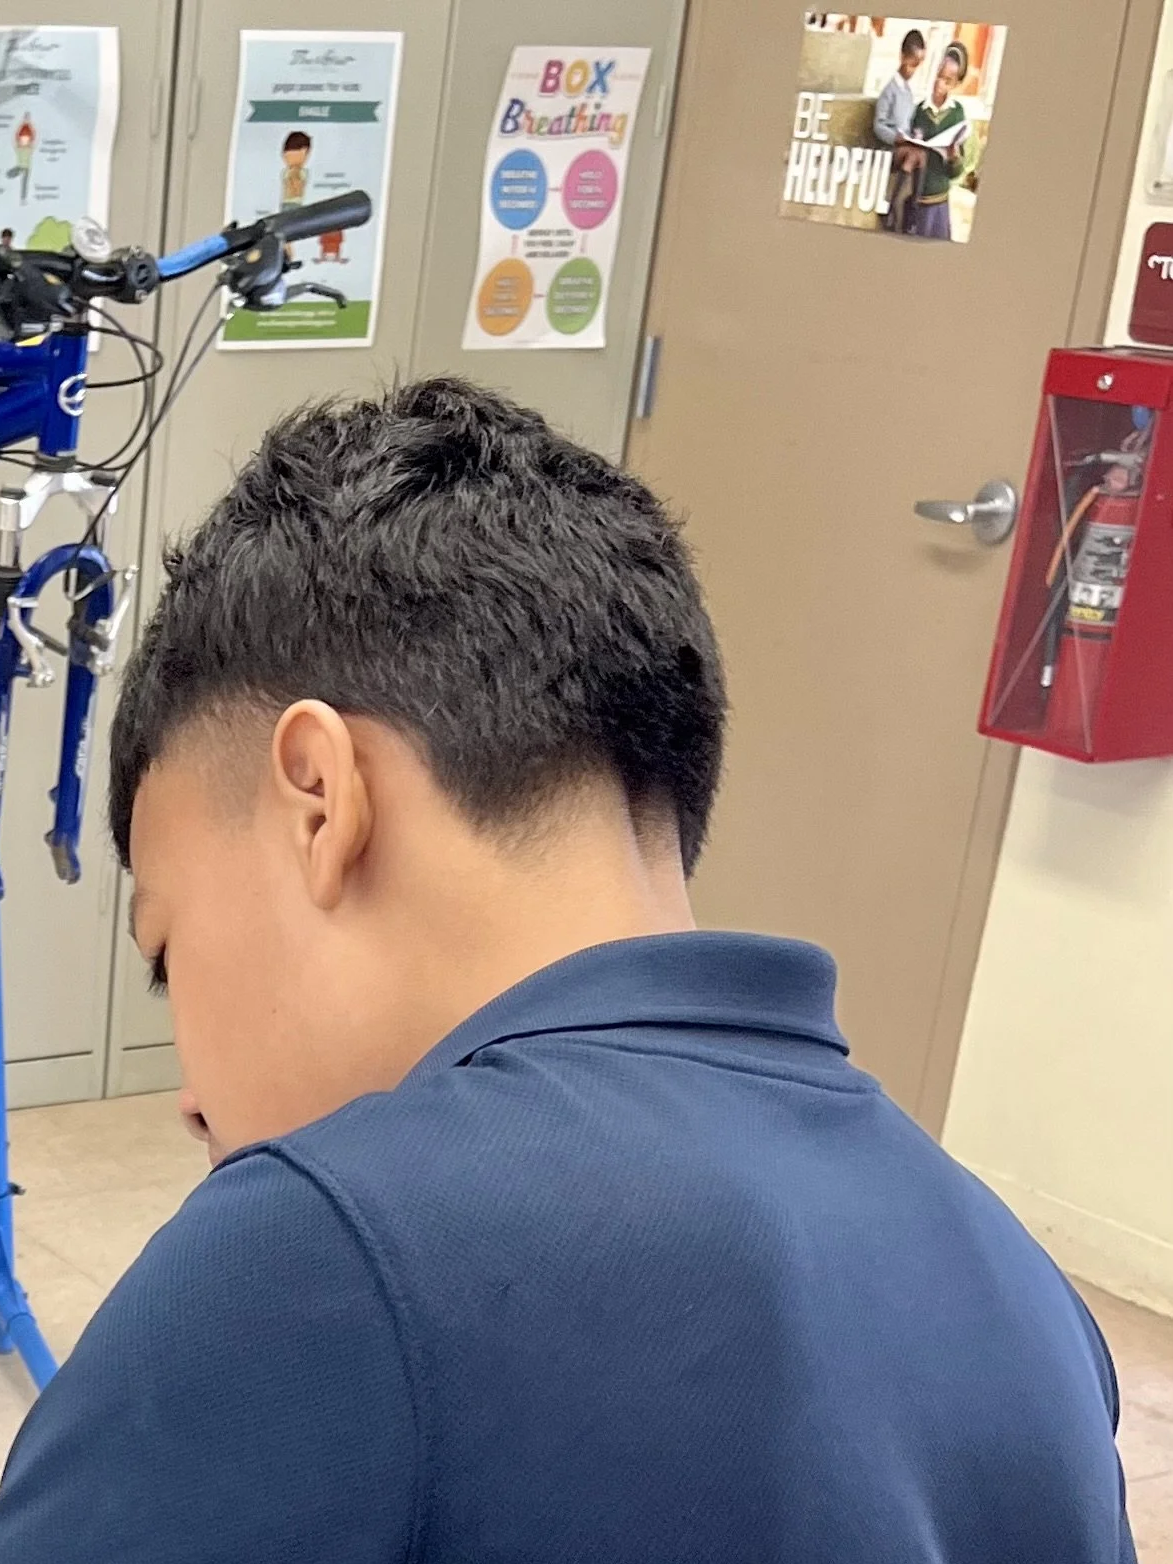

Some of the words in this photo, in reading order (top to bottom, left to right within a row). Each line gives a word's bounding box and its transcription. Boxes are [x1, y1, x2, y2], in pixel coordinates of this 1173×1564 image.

[538, 58, 616, 96] BOX
[499, 97, 629, 146] Breathing
[793, 91, 835, 141] BE
[783, 139, 893, 215] HELPFUL
